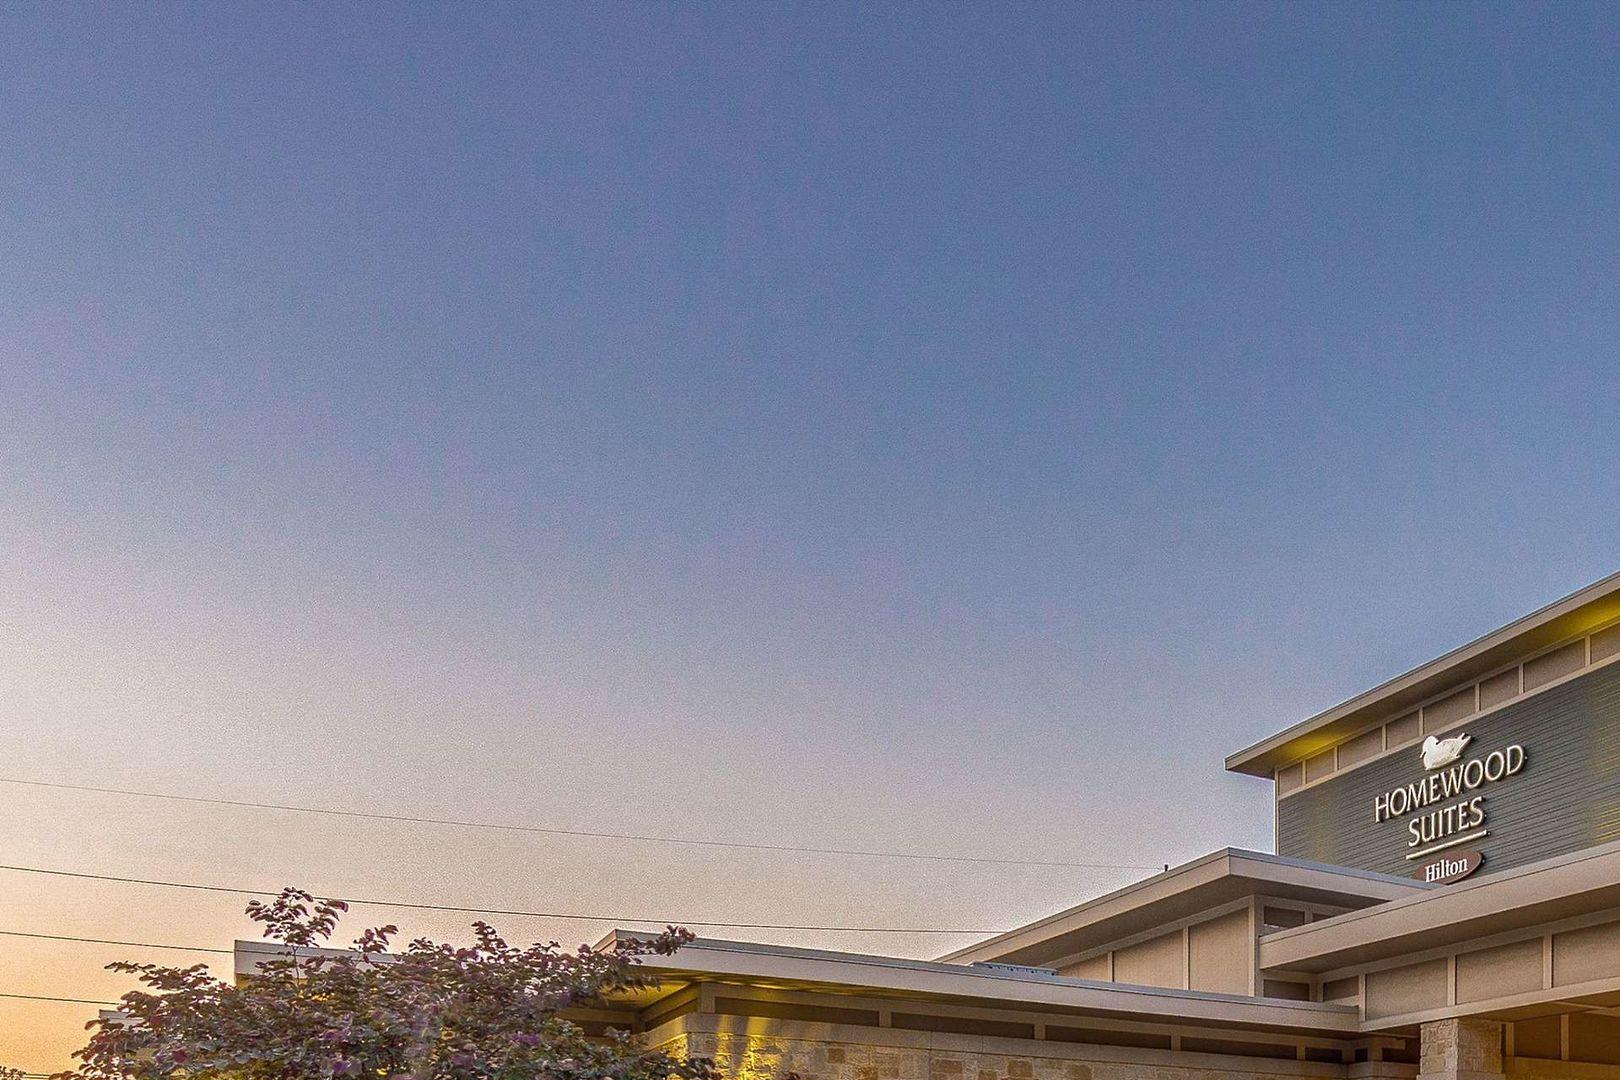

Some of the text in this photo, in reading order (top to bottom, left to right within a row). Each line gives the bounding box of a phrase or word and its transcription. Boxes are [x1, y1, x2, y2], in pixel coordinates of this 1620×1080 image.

[1375, 744, 1525, 824] HOMEWOOD
[1408, 796, 1485, 848] SUITES
[1425, 857, 1468, 883] Hilton
